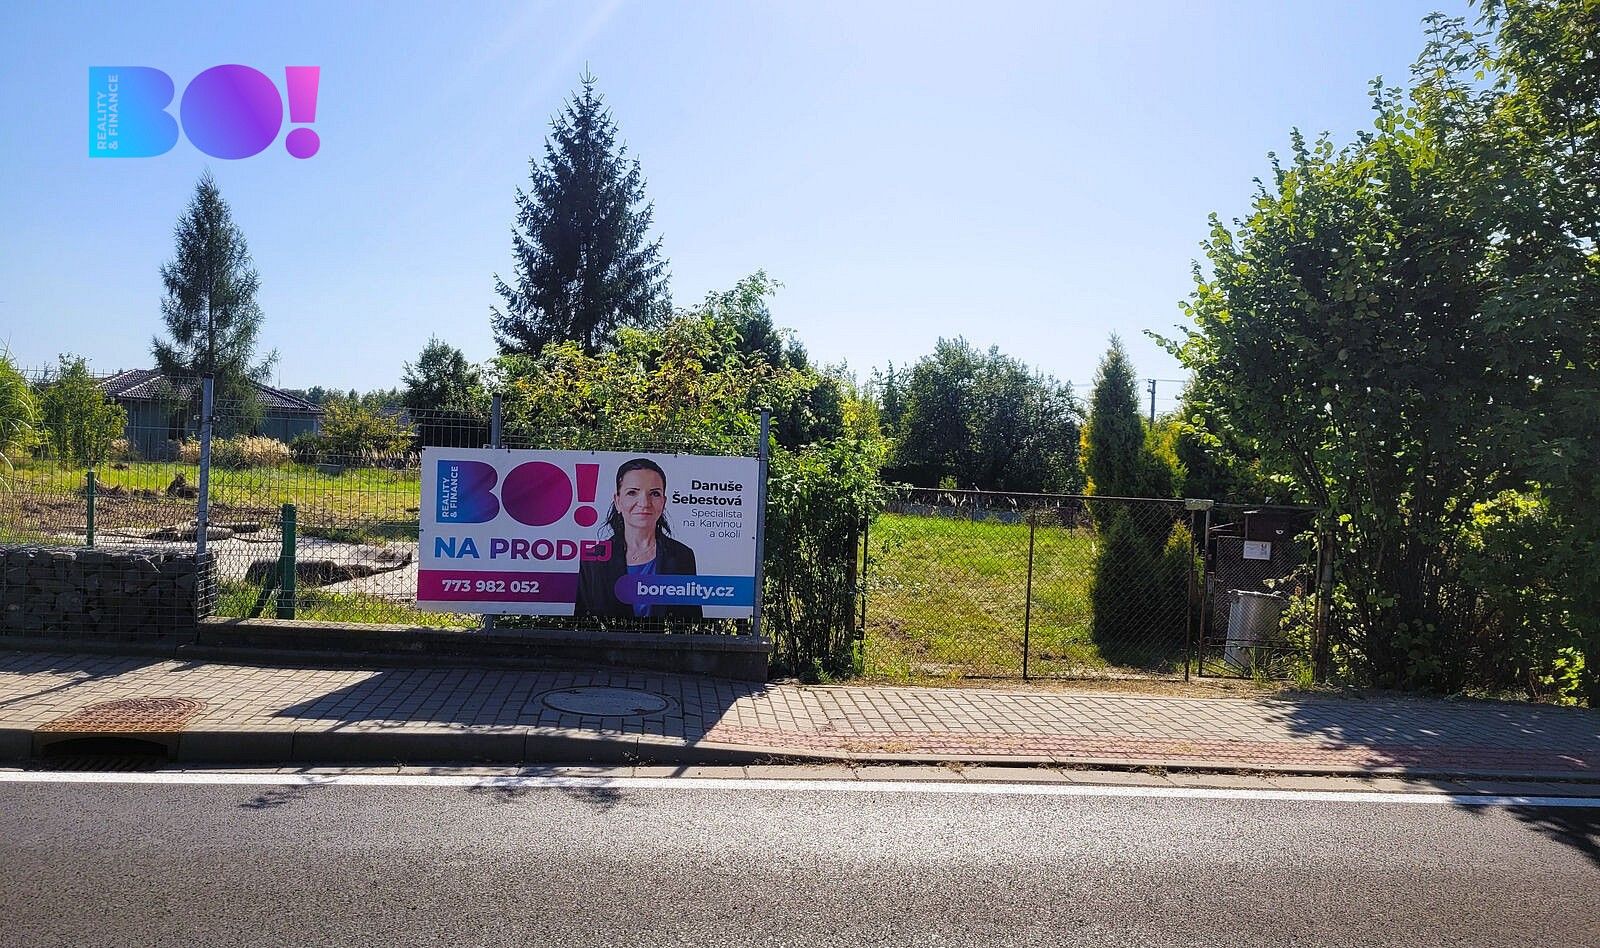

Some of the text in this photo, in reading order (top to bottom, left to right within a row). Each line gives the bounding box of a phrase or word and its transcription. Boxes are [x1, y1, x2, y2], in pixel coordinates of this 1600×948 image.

[436, 460, 600, 527] BO!
[450, 465, 459, 508] FINANCE
[691, 480, 743, 492] Danuše
[442, 477, 450, 518] REALITY
[672, 490, 742, 506] Šebestová
[691, 508, 743, 519] Specialista
[699, 519, 742, 529] Karvinou
[709, 530, 716, 538] a
[434, 537, 613, 562] NA PRODEJ
[442, 580, 540, 593] 773 982 052
[637, 582, 735, 600] boreality.cz
